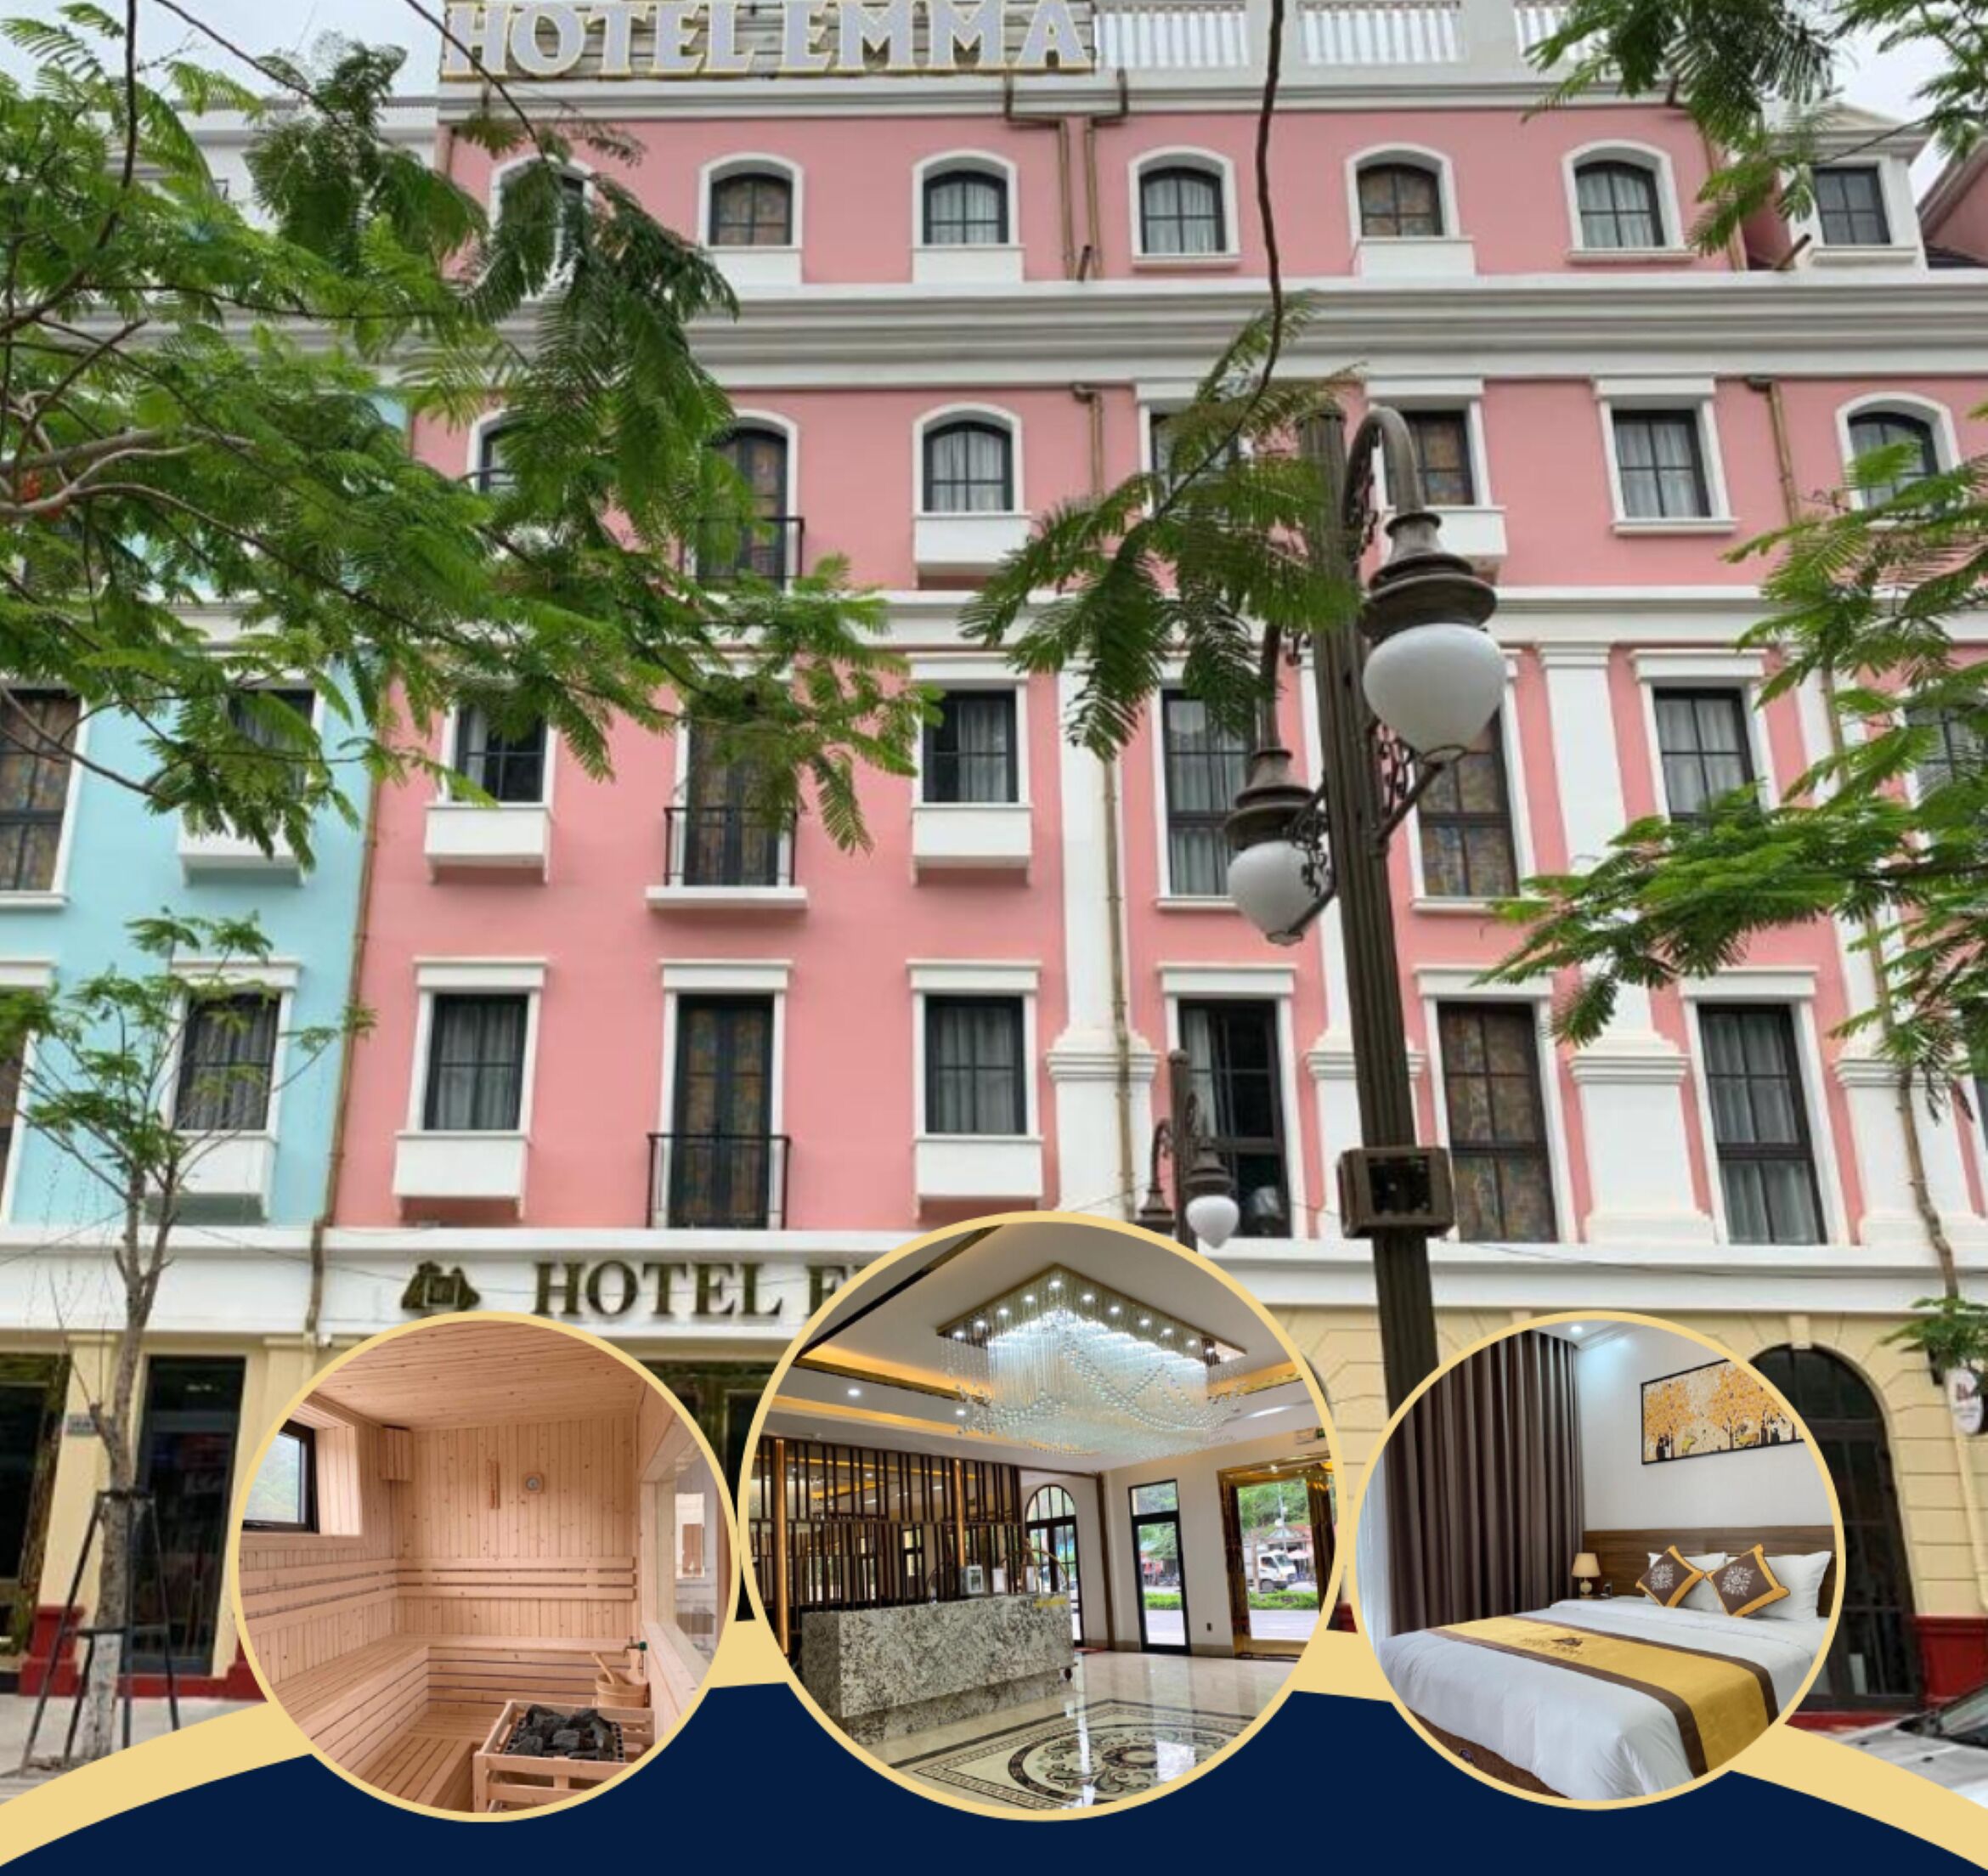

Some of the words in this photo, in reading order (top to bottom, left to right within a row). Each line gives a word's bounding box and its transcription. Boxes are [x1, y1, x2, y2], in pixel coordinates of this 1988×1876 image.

[441, 1, 755, 76] HOTEL
[778, 0, 1093, 73] EMMA
[531, 1260, 782, 1316] HOTEL
